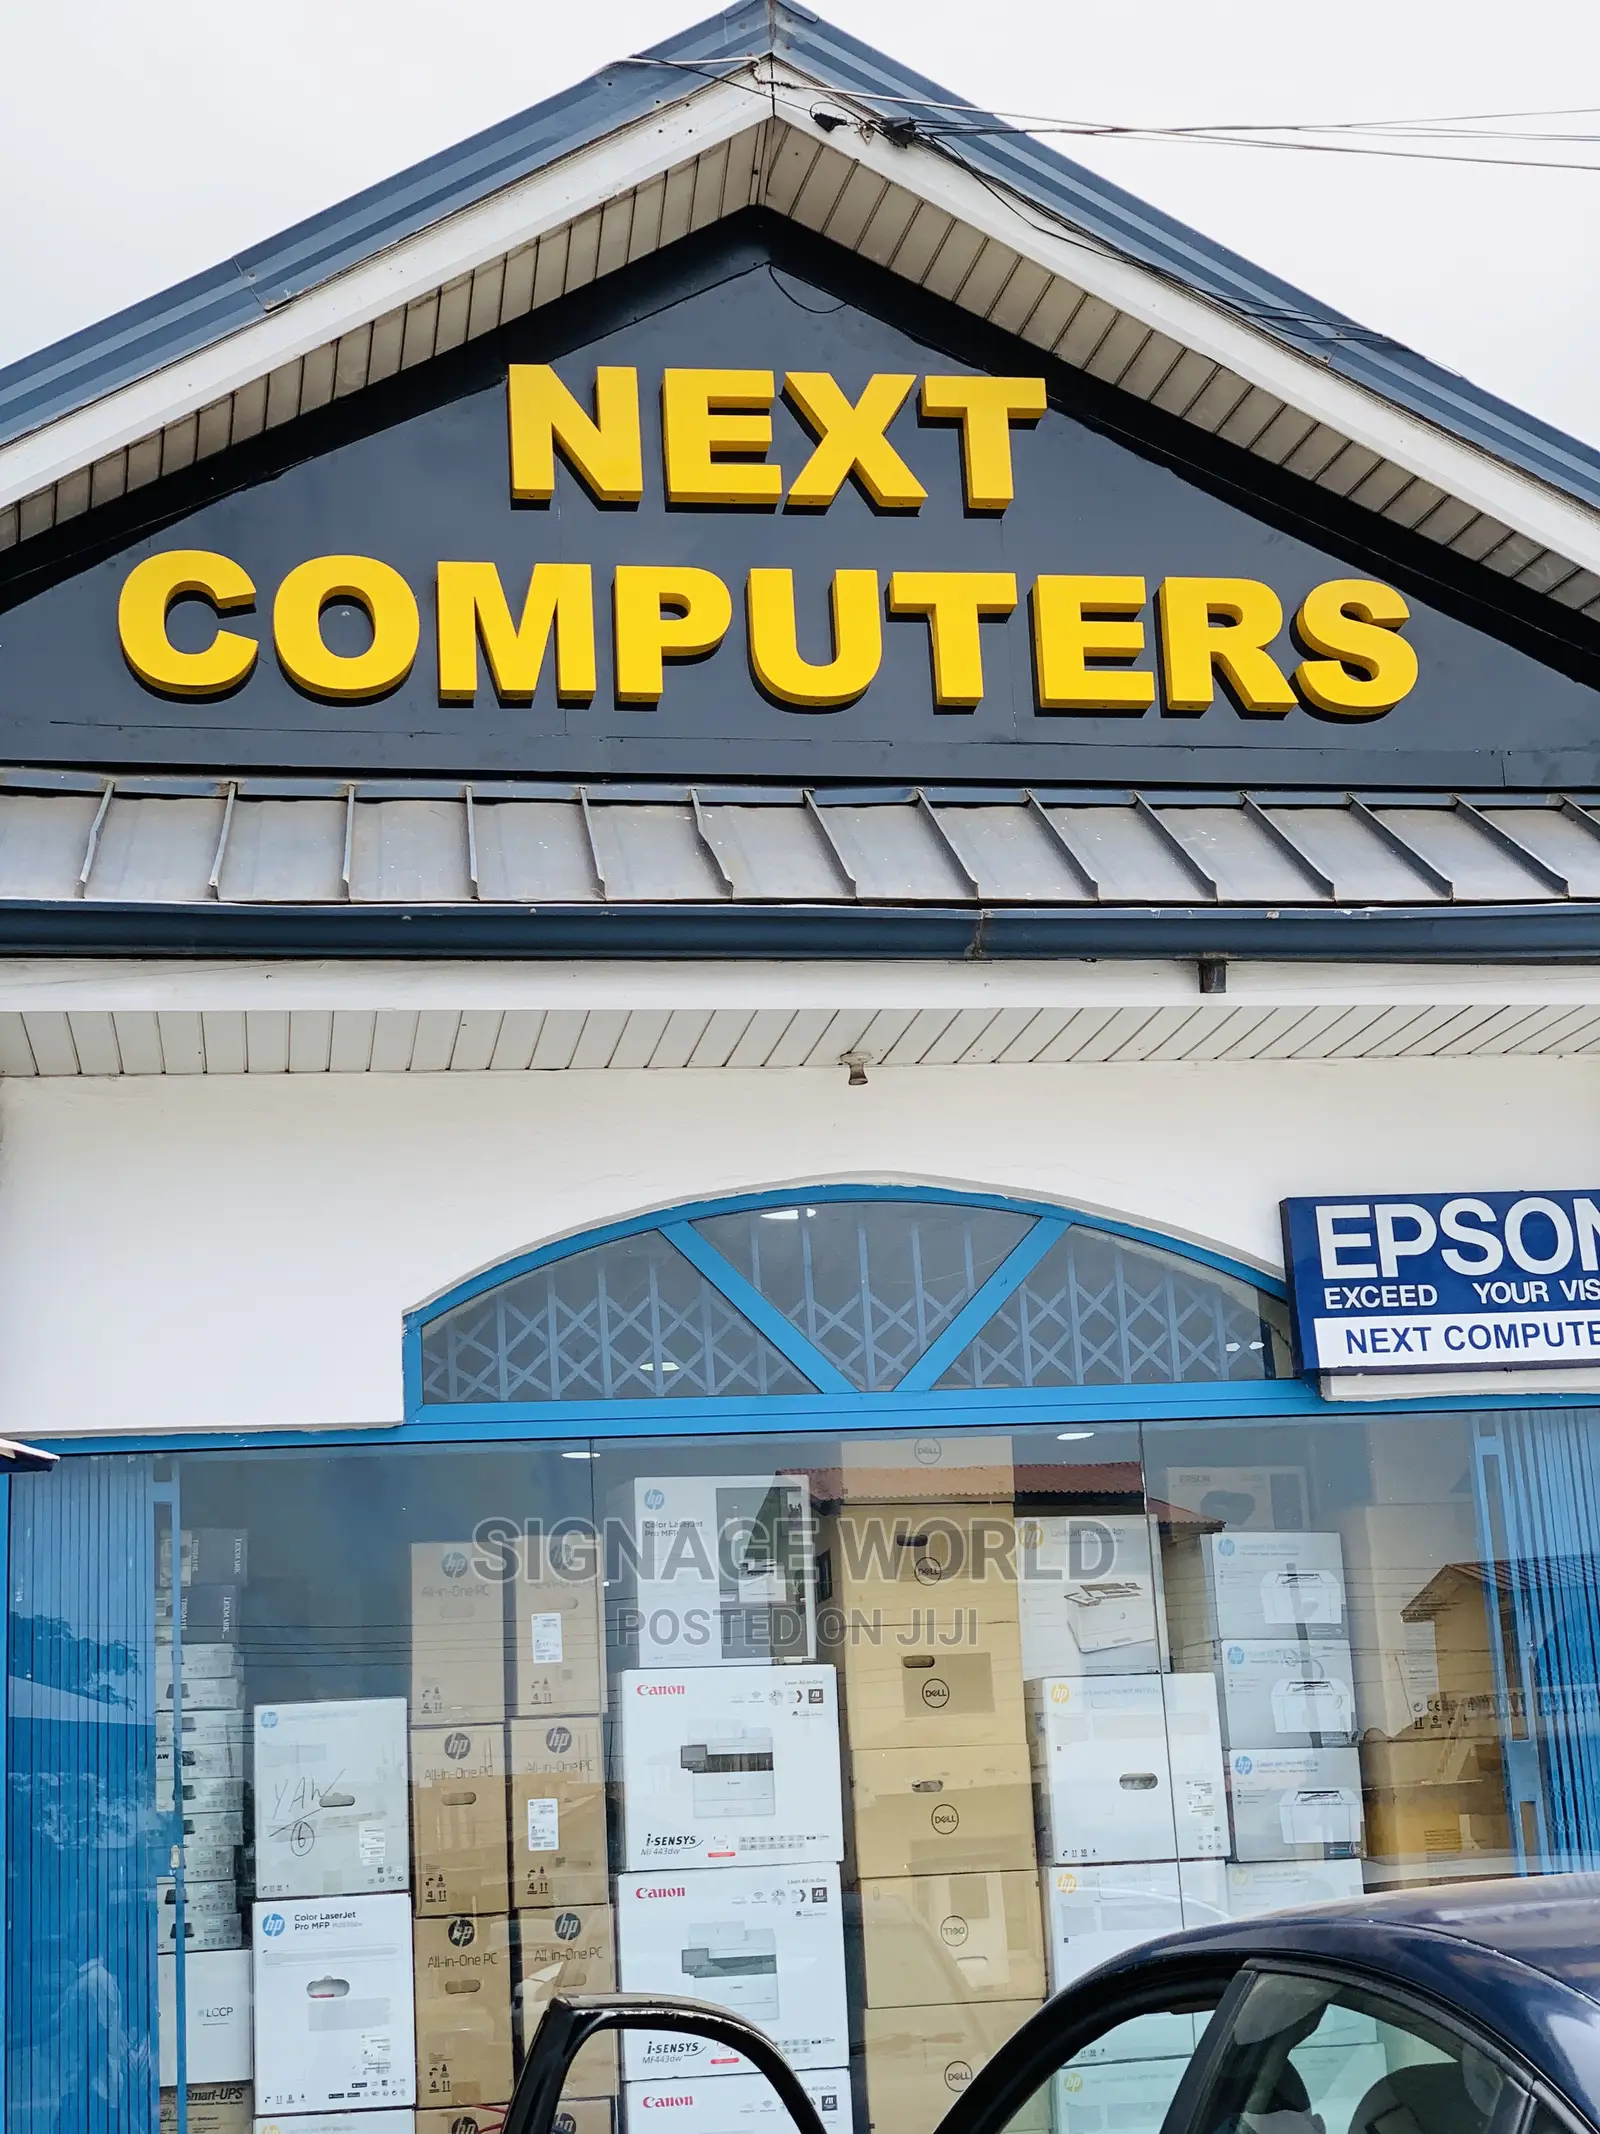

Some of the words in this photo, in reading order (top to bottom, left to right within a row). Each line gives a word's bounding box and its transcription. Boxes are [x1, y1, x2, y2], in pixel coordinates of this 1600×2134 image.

[508, 364, 1047, 510] NEXT
[118, 550, 1419, 716] COMPUTERS
[1324, 1284, 1438, 1309] EXCEED
[1472, 1280, 1550, 1304] YOUR
[1346, 1326, 1432, 1355] NEXT
[644, 1489, 665, 1510] hp
[442, 1552, 468, 1578] hp
[422, 1585, 473, 1598] All-in-One
[476, 1584, 490, 1596] PC
[636, 1684, 686, 1696] Canon
[925, 1689, 947, 1698] DELL
[1051, 1683, 1070, 1704] hp
[444, 1732, 471, 1760] hp
[546, 1726, 573, 1754] hp
[425, 1767, 477, 1780] All-in-One
[479, 1765, 494, 1779] PC
[525, 1760, 578, 1773] All-in-One
[580, 1759, 594, 1772] PC
[1235, 1755, 1253, 1776] hp
[934, 1815, 957, 1824] DELL
[646, 1833, 697, 1847] i-SENSYS
[1057, 1873, 1077, 1894] hp
[635, 1886, 686, 1899] Canon
[294, 1913, 319, 1922] Color
[320, 1910, 357, 1920] LaserJet
[263, 1914, 285, 1937] hp
[294, 1922, 310, 1931] Pro
[312, 1921, 331, 1930] MFP
[448, 1919, 475, 1947] hp
[555, 1913, 581, 1940] hp
[428, 1954, 481, 1968] All-in-One
[483, 1952, 498, 1965] PC
[534, 1948, 587, 1962] All-in-One
[589, 1946, 604, 1959] PC
[647, 2041, 699, 2054] i-SENSYS
[642, 2054, 683, 2064] MF443dw
[947, 2072, 970, 2081] DELL
[642, 2095, 693, 2109] Canon
